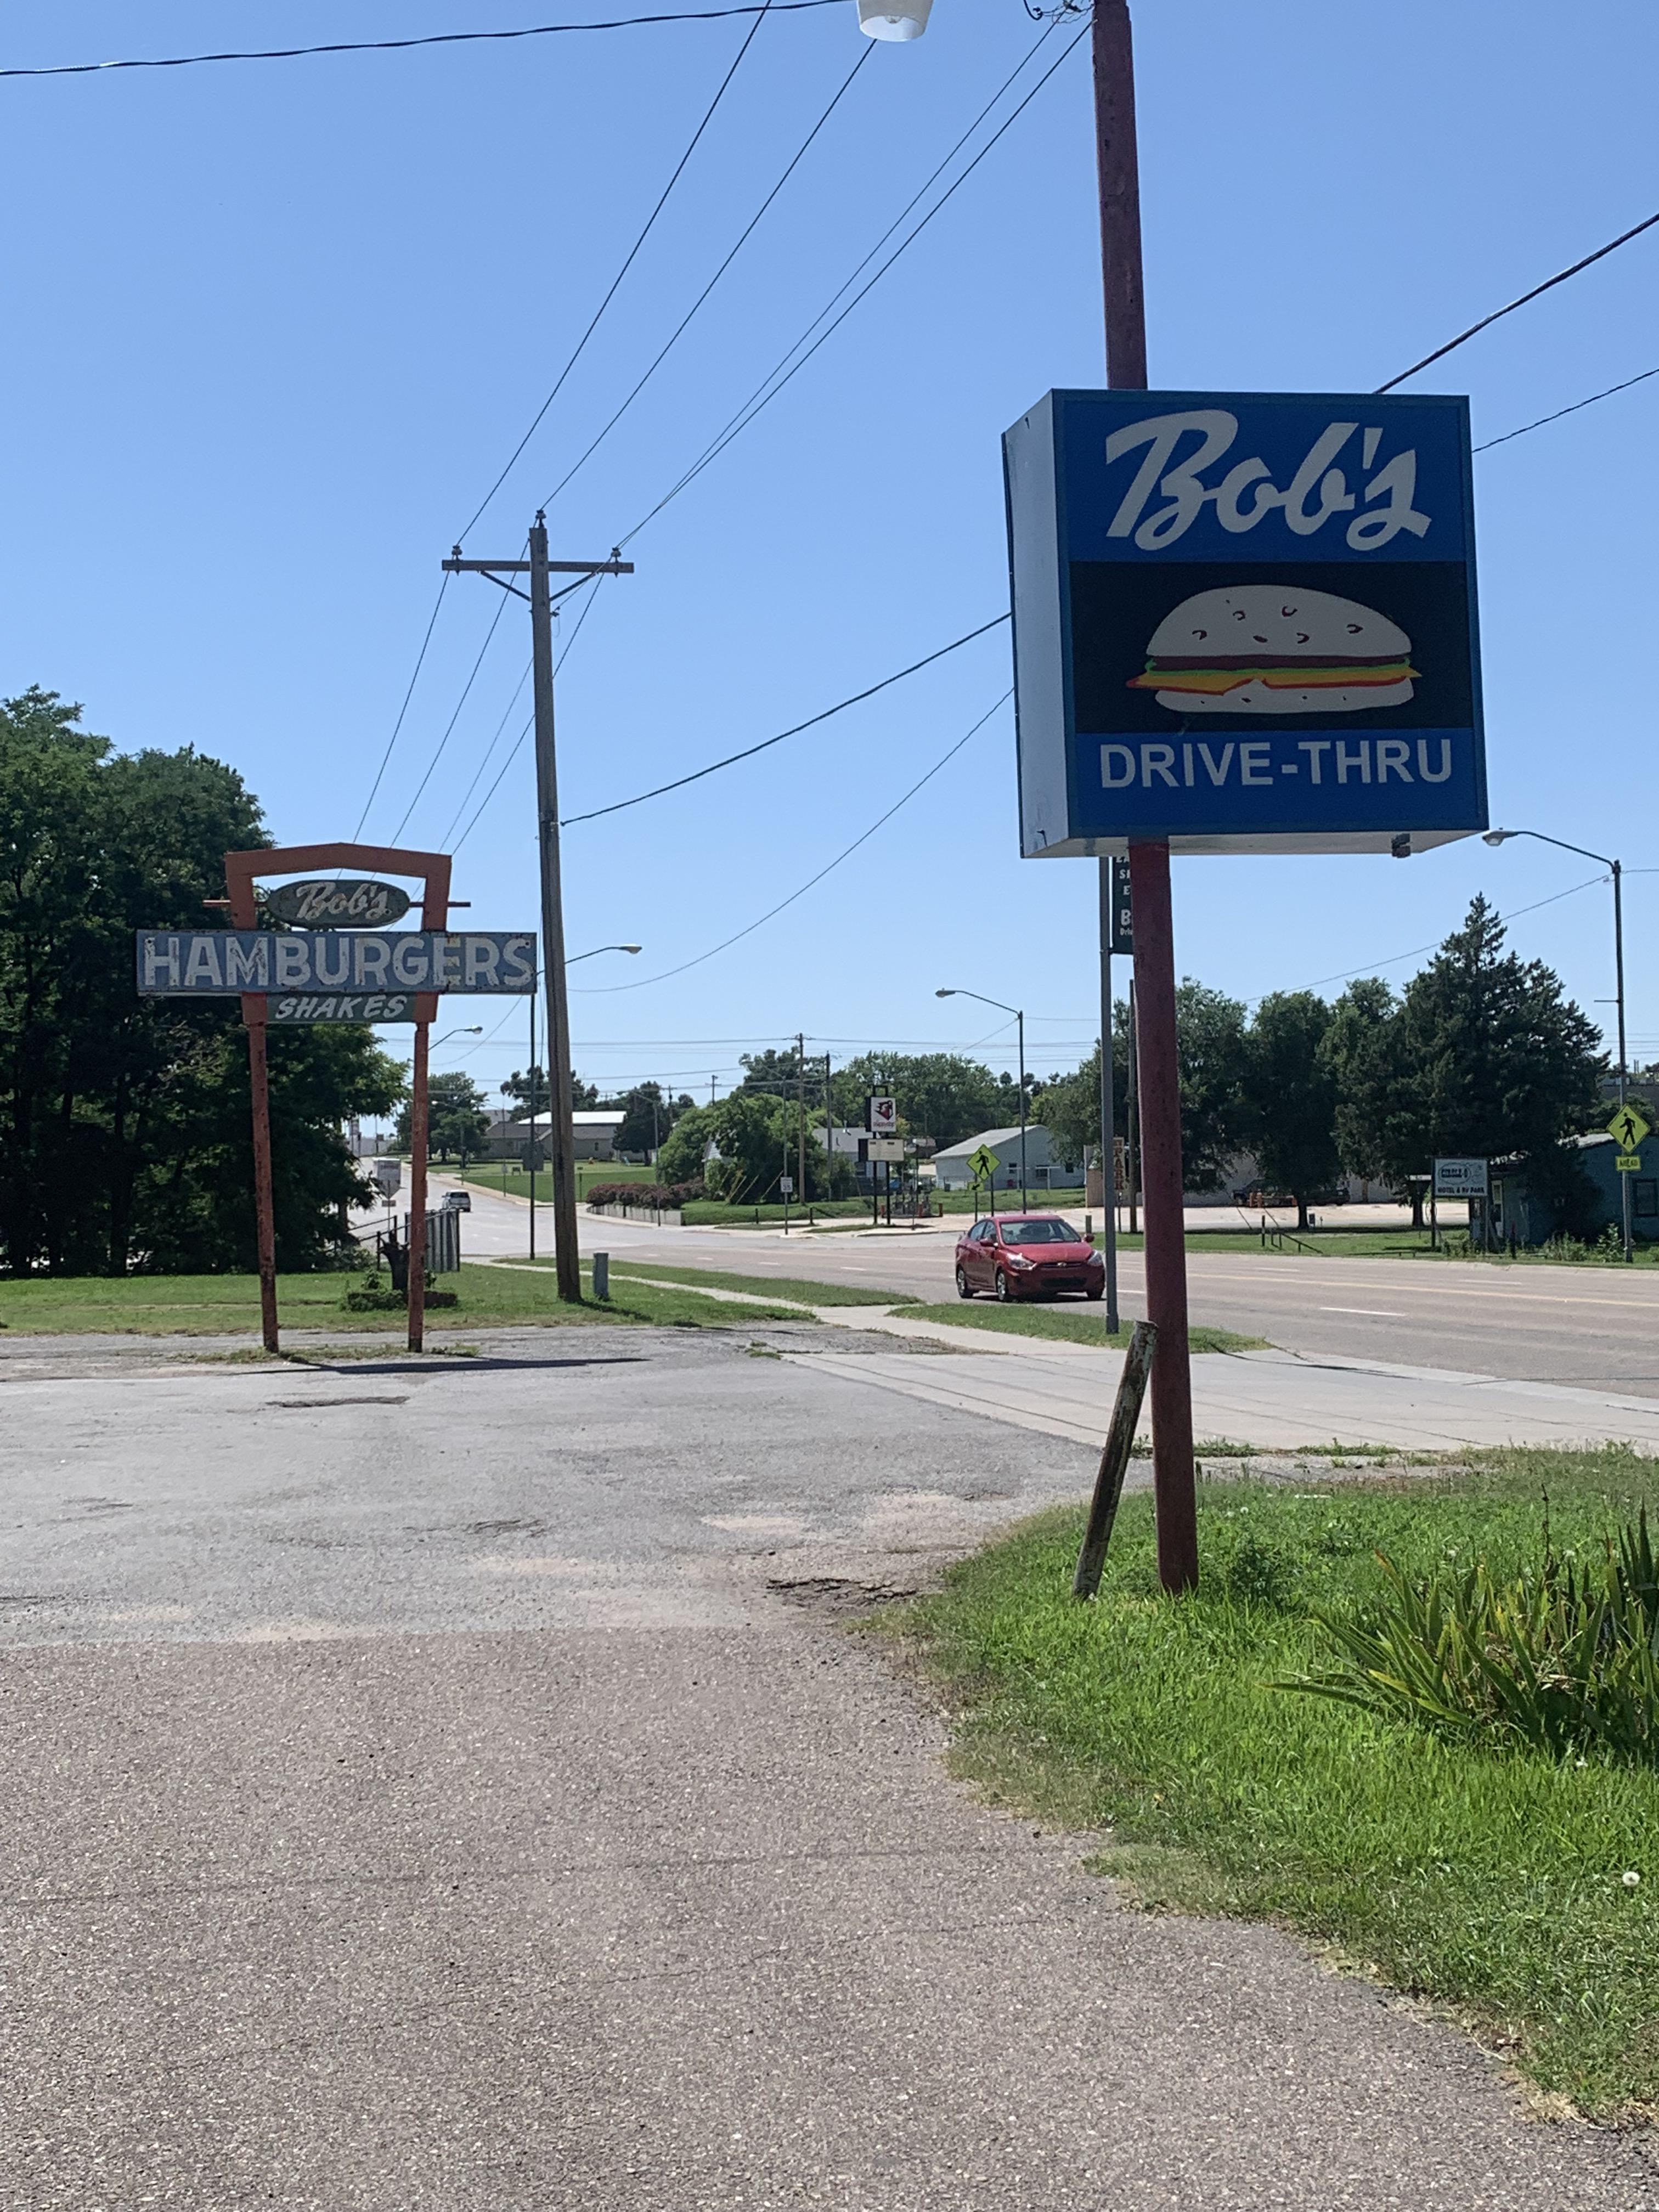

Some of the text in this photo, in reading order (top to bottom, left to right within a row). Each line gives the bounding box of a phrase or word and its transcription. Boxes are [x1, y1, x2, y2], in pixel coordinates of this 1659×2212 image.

[1105, 409, 1432, 551] Bob's
[1100, 738, 1452, 788] DRIVE-THRU
[296, 882, 391, 921] Bob's
[143, 937, 532, 987] HAMBURGERS
[275, 995, 407, 1019] SHAKES
